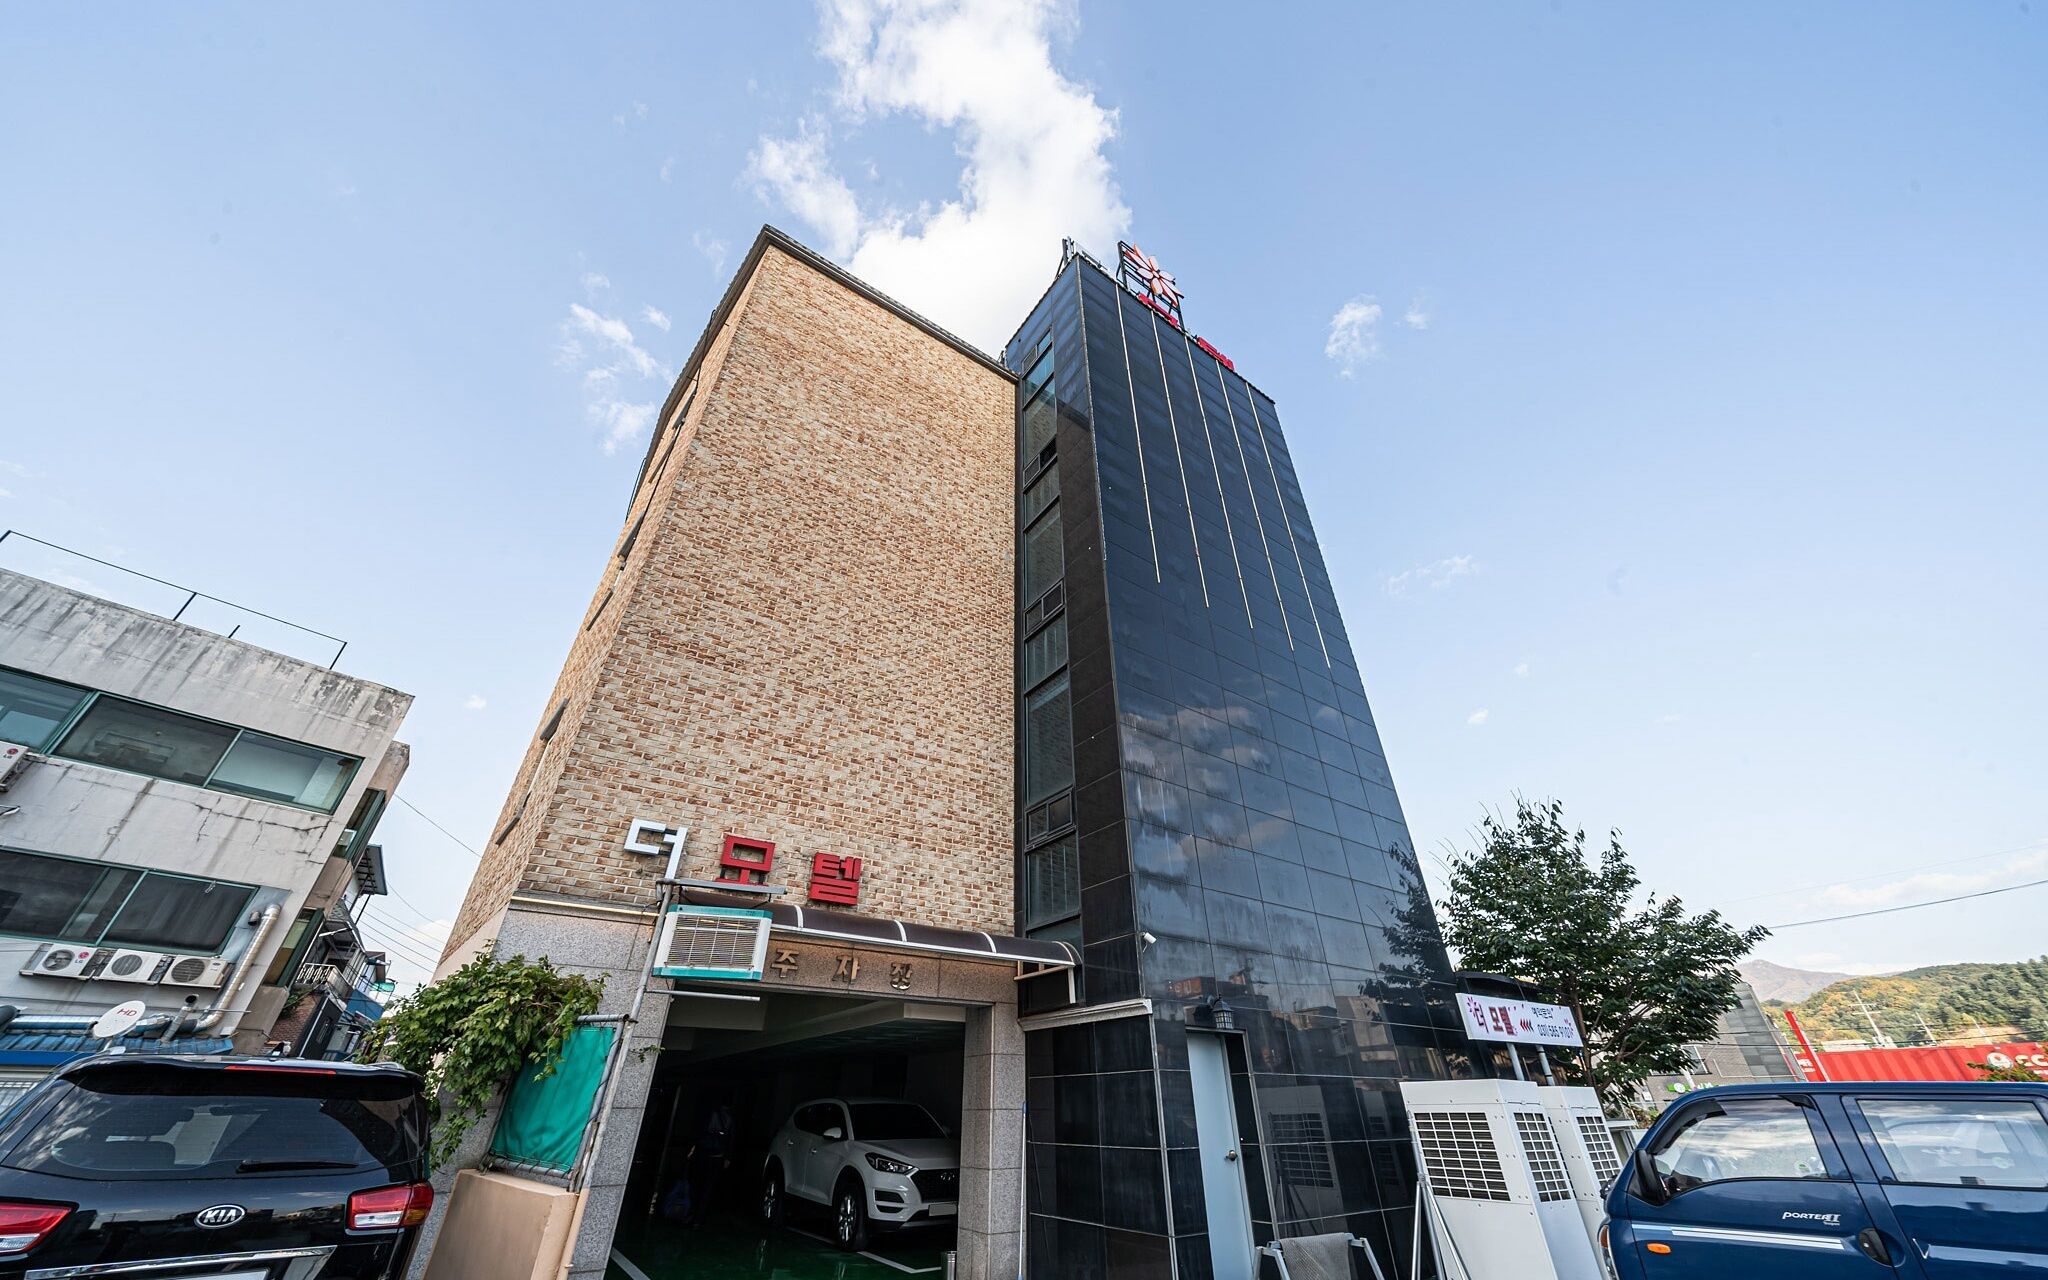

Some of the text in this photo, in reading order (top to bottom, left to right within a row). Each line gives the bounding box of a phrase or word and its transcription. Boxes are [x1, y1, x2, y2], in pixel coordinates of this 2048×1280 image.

[624, 818, 688, 879] 더
[116, 1008, 138, 1016] HD
[1474, 1003, 1514, 1035] 더 모텔
[203, 1209, 236, 1223] KIA
